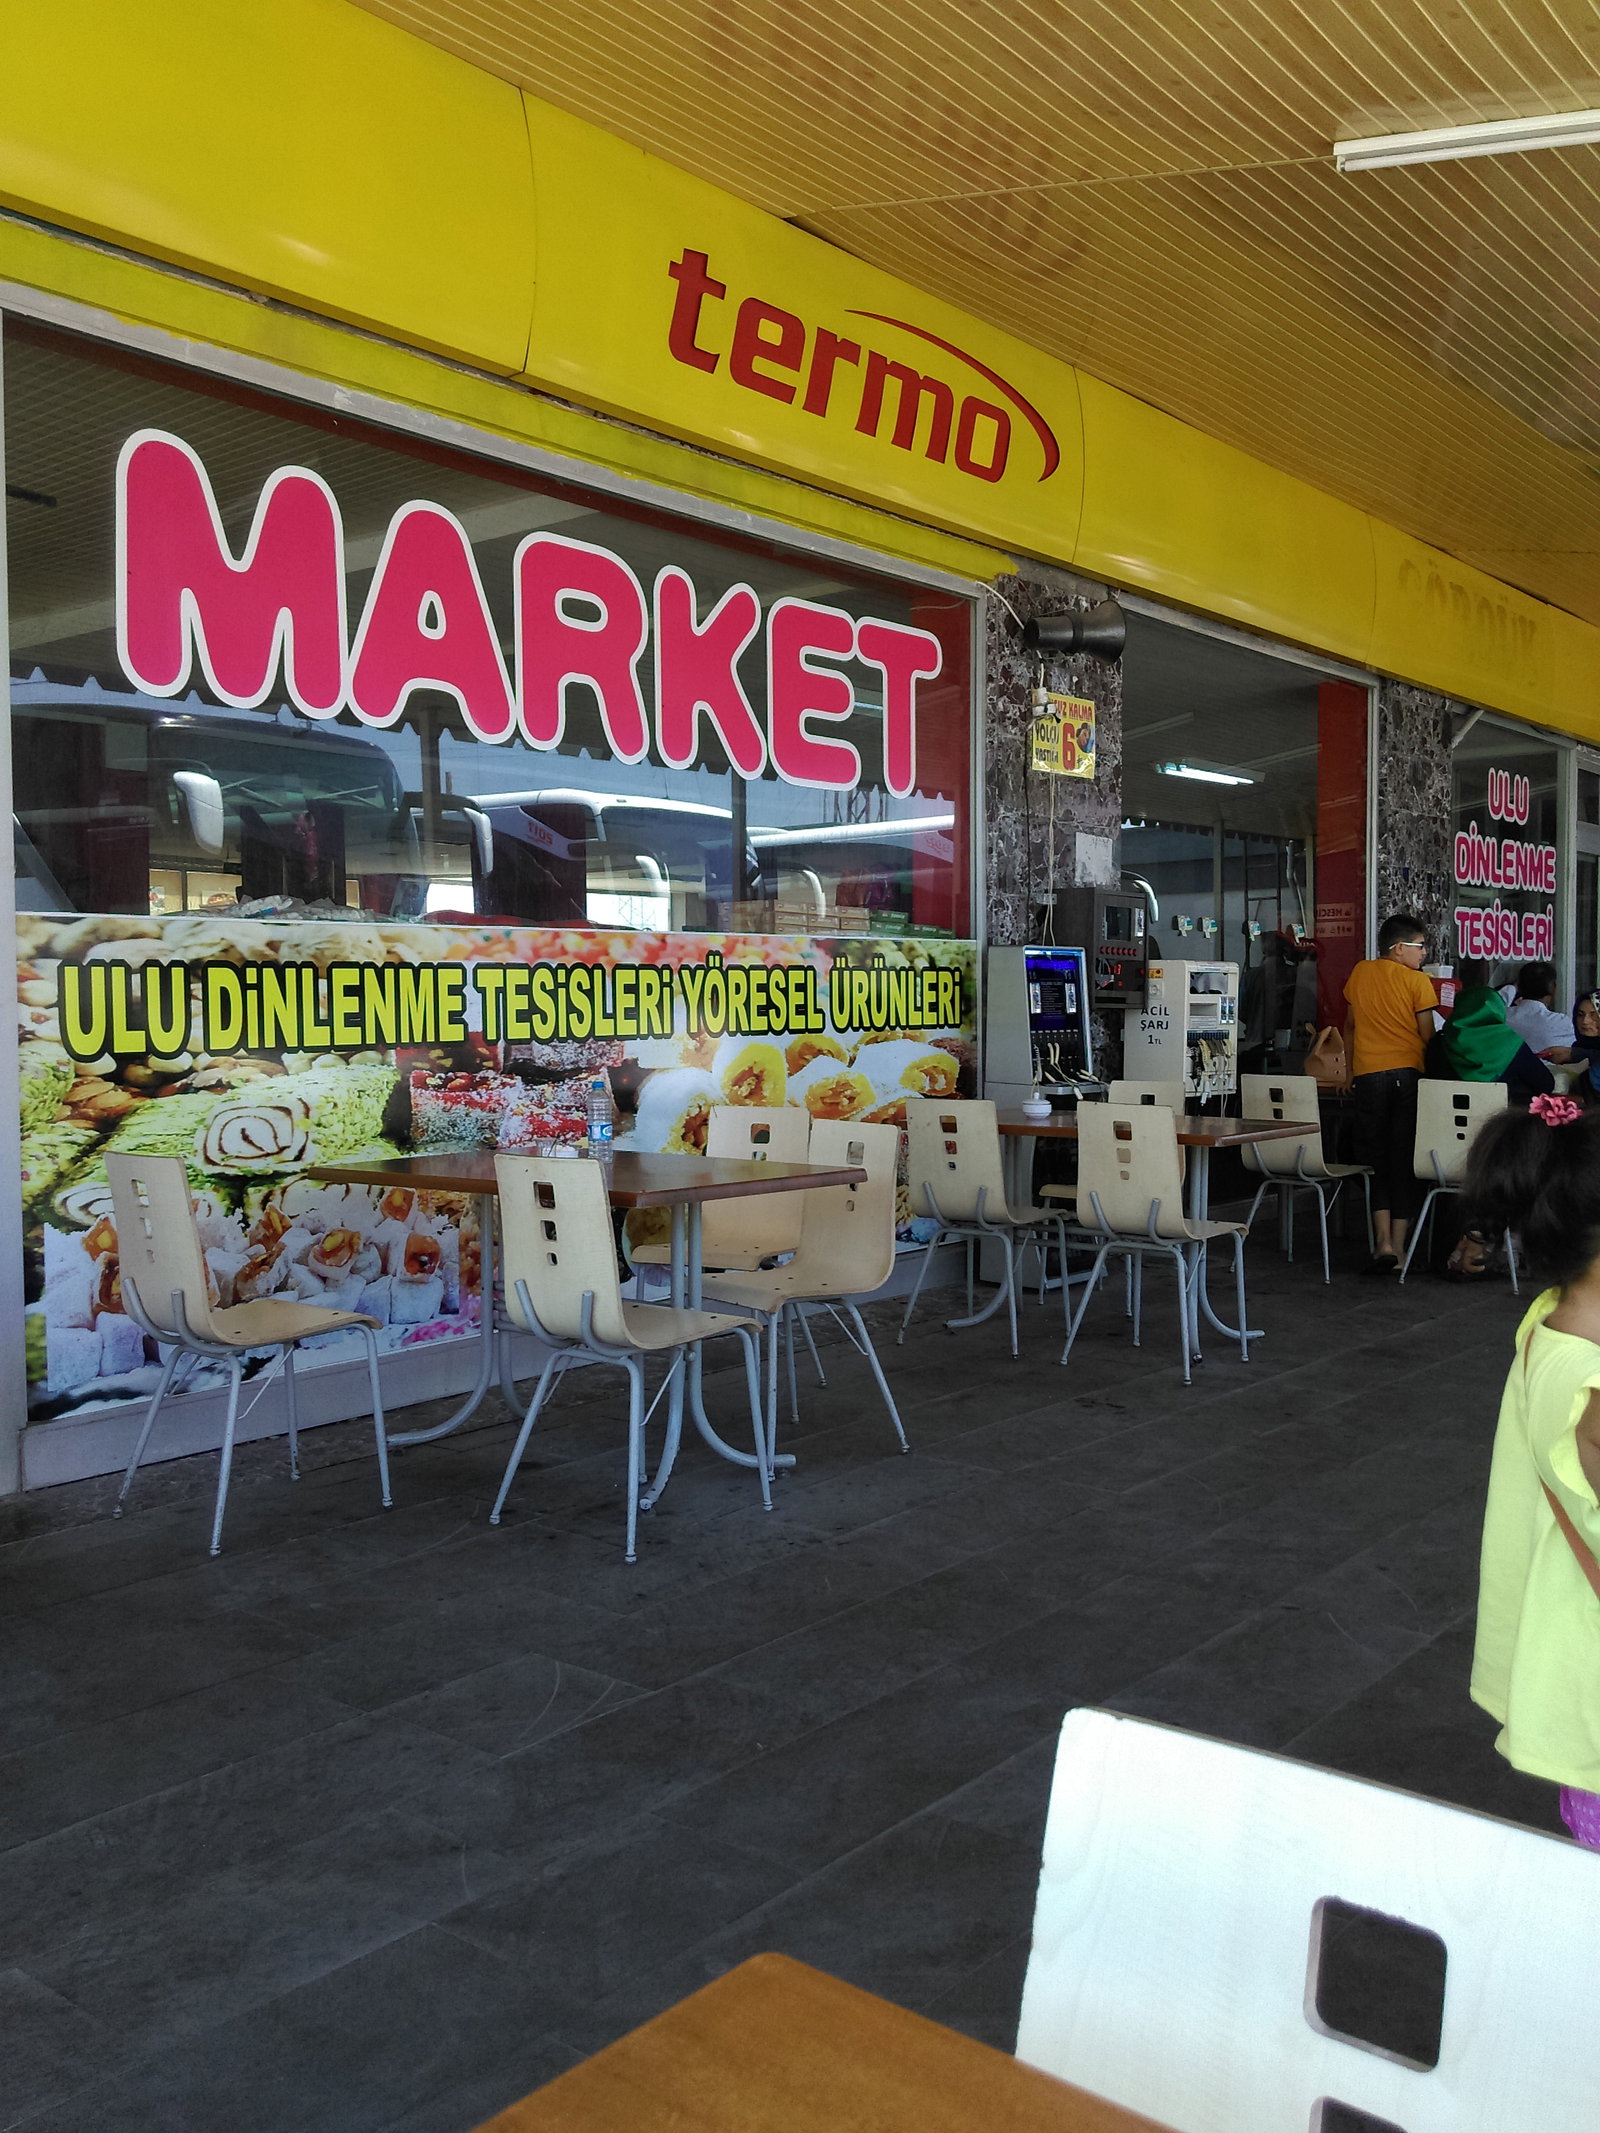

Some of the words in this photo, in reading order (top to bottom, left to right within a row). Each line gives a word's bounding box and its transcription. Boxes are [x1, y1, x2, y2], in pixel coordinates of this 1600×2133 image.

[667, 247, 1012, 484] termo
[118, 430, 941, 798] MARKET
[1062, 722, 1076, 770] 6
[1488, 767, 1530, 826] ULU
[1455, 820, 1556, 893] DİNLENME
[1455, 898, 1554, 961] TESİSLERİ
[60, 961, 188, 1059] ULU
[678, 952, 826, 1036] YÖRESEL
[1140, 1004, 1170, 1016] ACİL
[1140, 1020, 1169, 1032] ŞARJ
